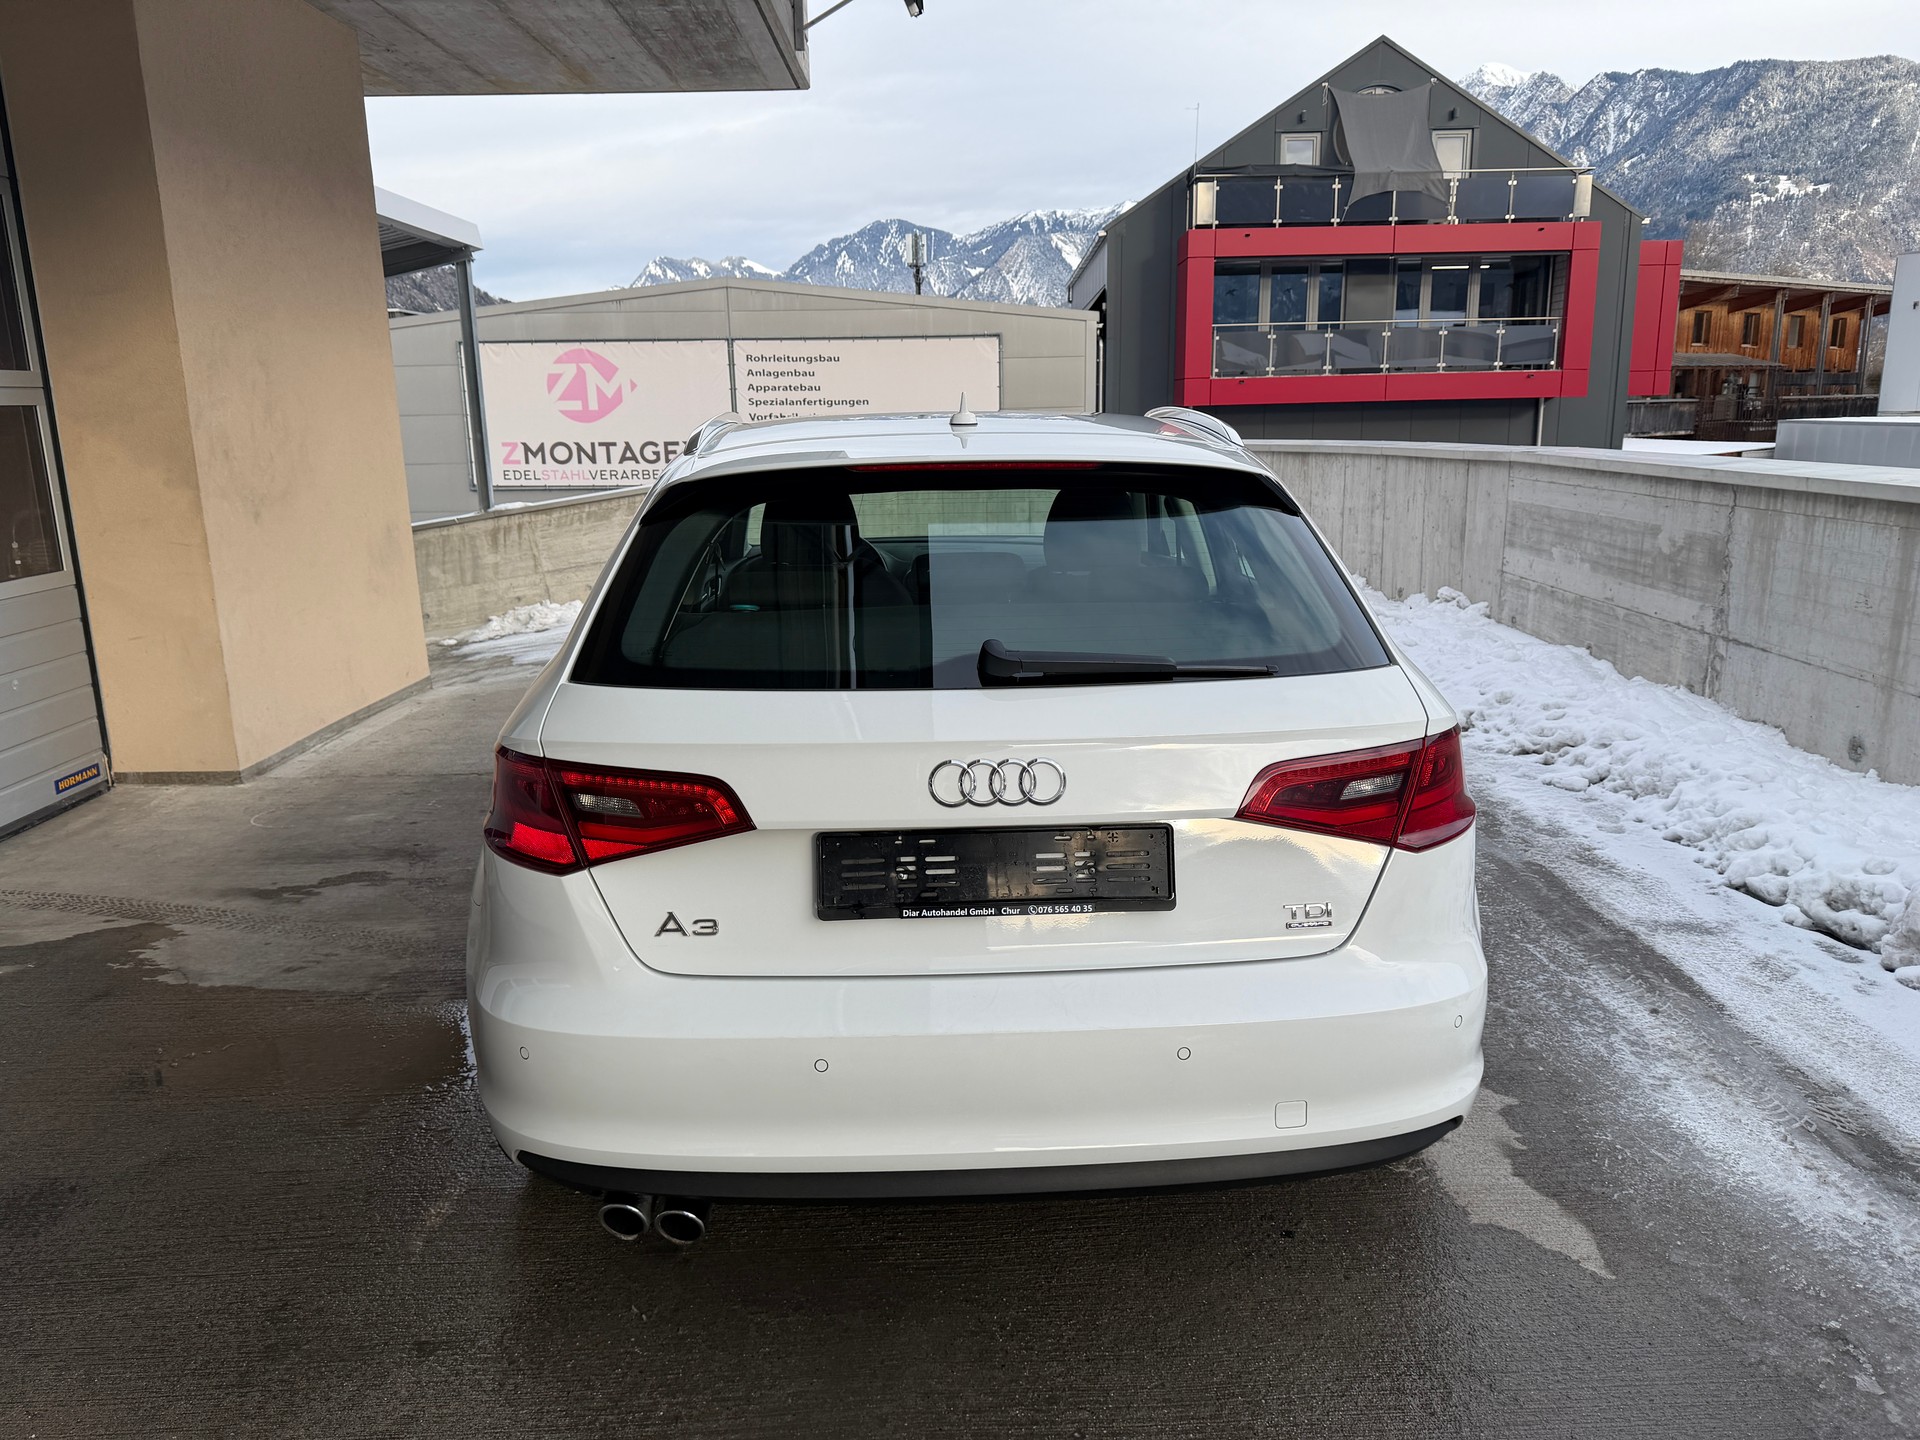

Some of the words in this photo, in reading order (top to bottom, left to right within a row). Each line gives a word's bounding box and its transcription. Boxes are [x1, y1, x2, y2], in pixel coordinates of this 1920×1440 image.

[745, 353, 841, 365] Rohrleitungsbau
[746, 368, 816, 379] Anlagenbau
[747, 383, 821, 393] Apparatebau
[748, 397, 870, 408] Spezialanfertigungen
[501, 440, 688, 465] ZMONTAGE
[503, 469, 664, 481] EDELSTAHLVERARBE
[902, 909, 920, 917] Diar
[921, 907, 968, 917] Autohandel
[969, 907, 995, 916] GmbH
[1001, 907, 1021, 915] Chur
[1038, 905, 1053, 914] 076
[1054, 905, 1070, 913] 565
[1071, 905, 1082, 913] 40
[1083, 904, 1093, 913] 35
[1283, 902, 1332, 920] TDI
[654, 911, 719, 937] A3
